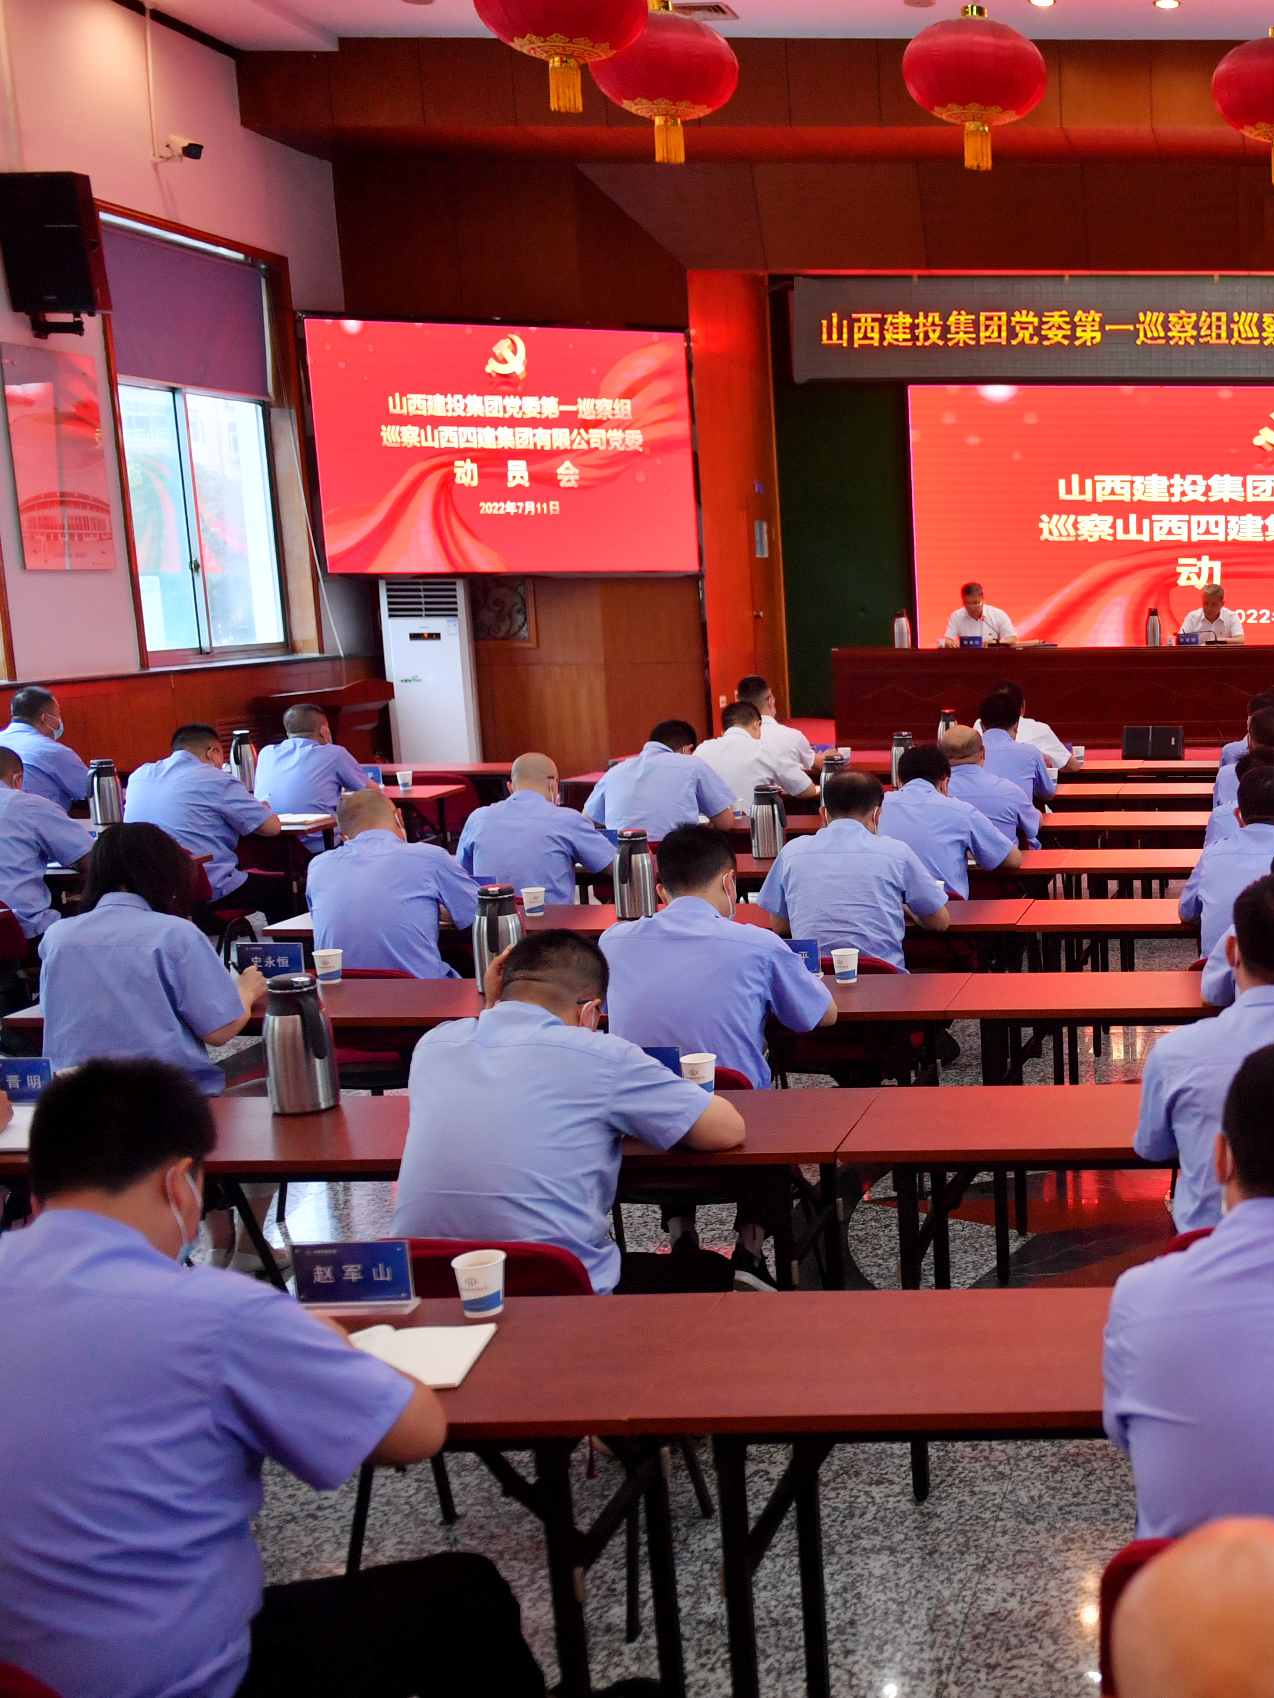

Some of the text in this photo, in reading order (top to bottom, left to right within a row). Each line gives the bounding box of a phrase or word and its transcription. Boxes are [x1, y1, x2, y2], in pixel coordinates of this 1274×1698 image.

[388, 393, 632, 420] 山西建投集团党委第一巡察组
[381, 425, 643, 451] 巡察山西四建集团有限公司党委
[479, 501, 560, 515] 2022年7月11日
[251, 956, 290, 968] 史永恒
[313, 1263, 393, 1284] 赵军山
